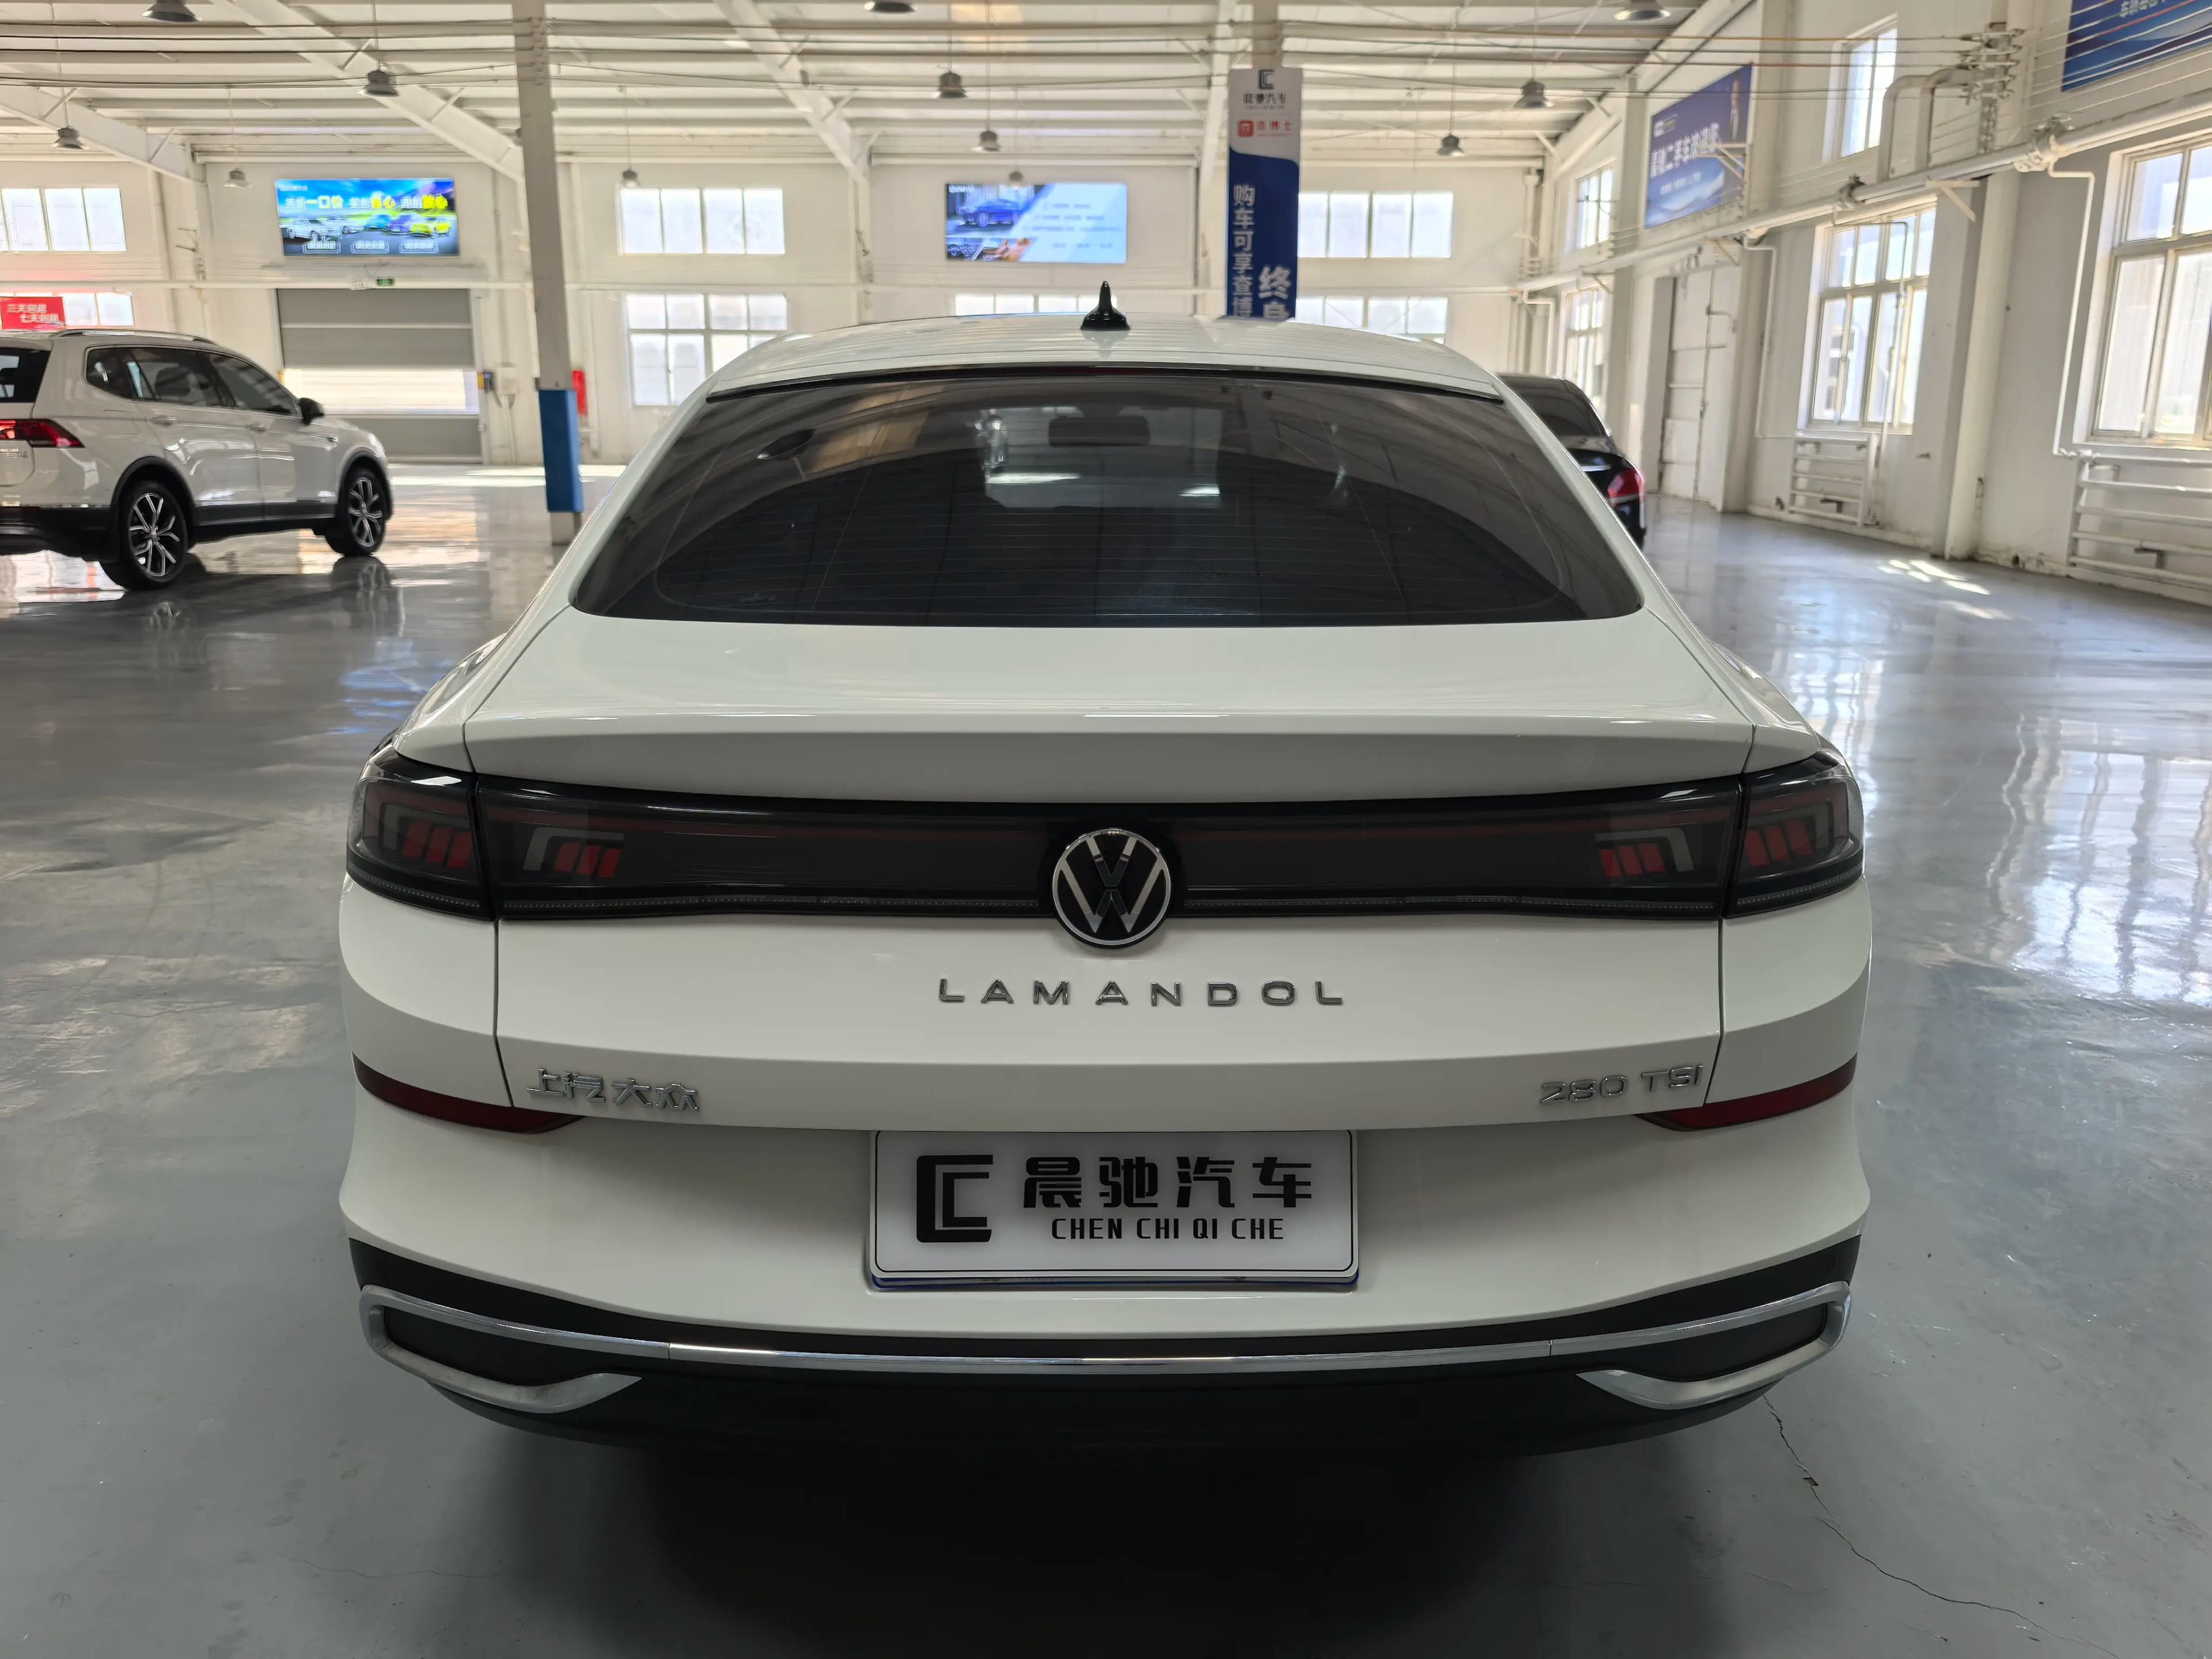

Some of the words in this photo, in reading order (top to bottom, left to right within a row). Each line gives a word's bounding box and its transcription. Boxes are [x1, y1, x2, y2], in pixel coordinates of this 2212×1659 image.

[938, 978, 1343, 1006] LAMANDOL
[527, 1068, 700, 1112] 上汽大众
[1540, 1075, 1628, 1104] 280
[1642, 1065, 1704, 1092] TSI
[1024, 1156, 1312, 1209] 晨驰汽车
[1051, 1218, 1123, 1240] CHEN
[1136, 1218, 1179, 1240] CHI
[1193, 1218, 1219, 1240] QI
[1231, 1218, 1284, 1240] CHE
